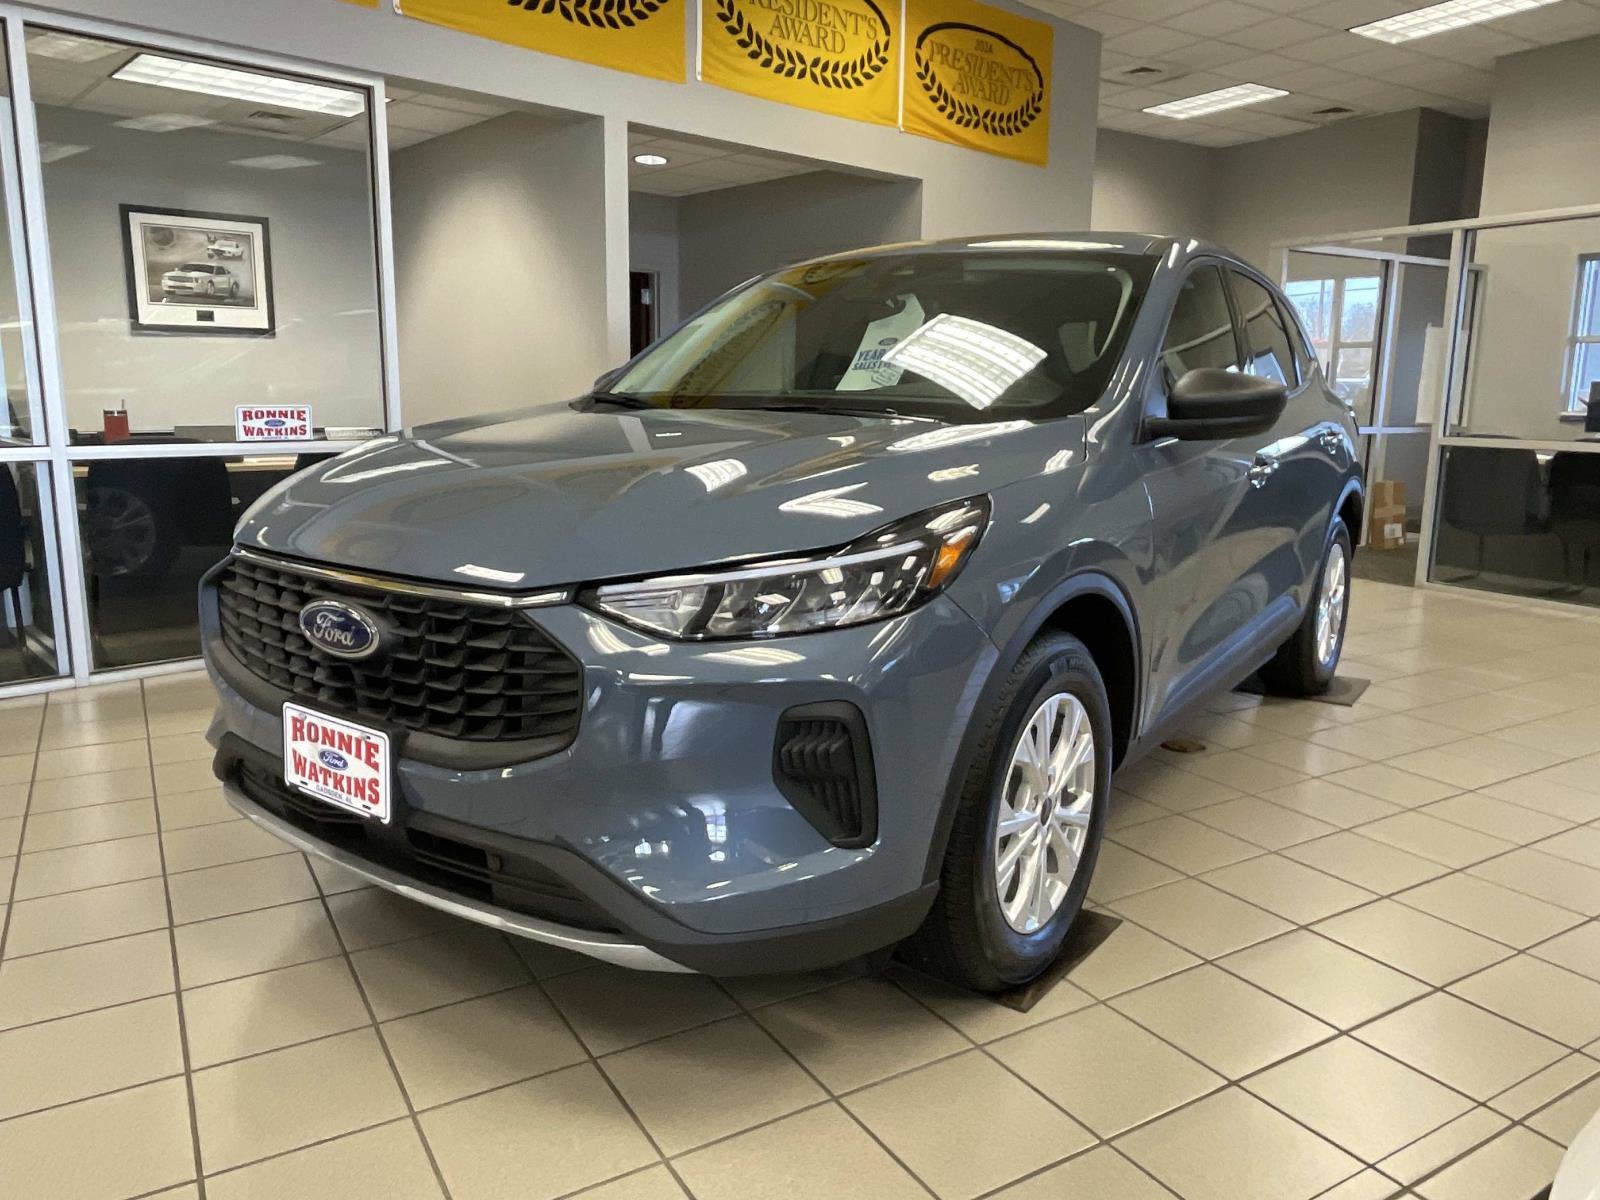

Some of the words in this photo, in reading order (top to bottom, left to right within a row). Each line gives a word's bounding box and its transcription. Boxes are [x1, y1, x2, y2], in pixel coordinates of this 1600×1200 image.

[768, 14, 846, 54] AWARD
[952, 72, 1010, 106] AWARD
[242, 409, 307, 422] RONNIE
[243, 424, 307, 437] WATKINS
[313, 611, 356, 647] Ford
[290, 714, 380, 773] RONNIE
[322, 750, 346, 768] Ford
[291, 747, 380, 805] WATKINS
